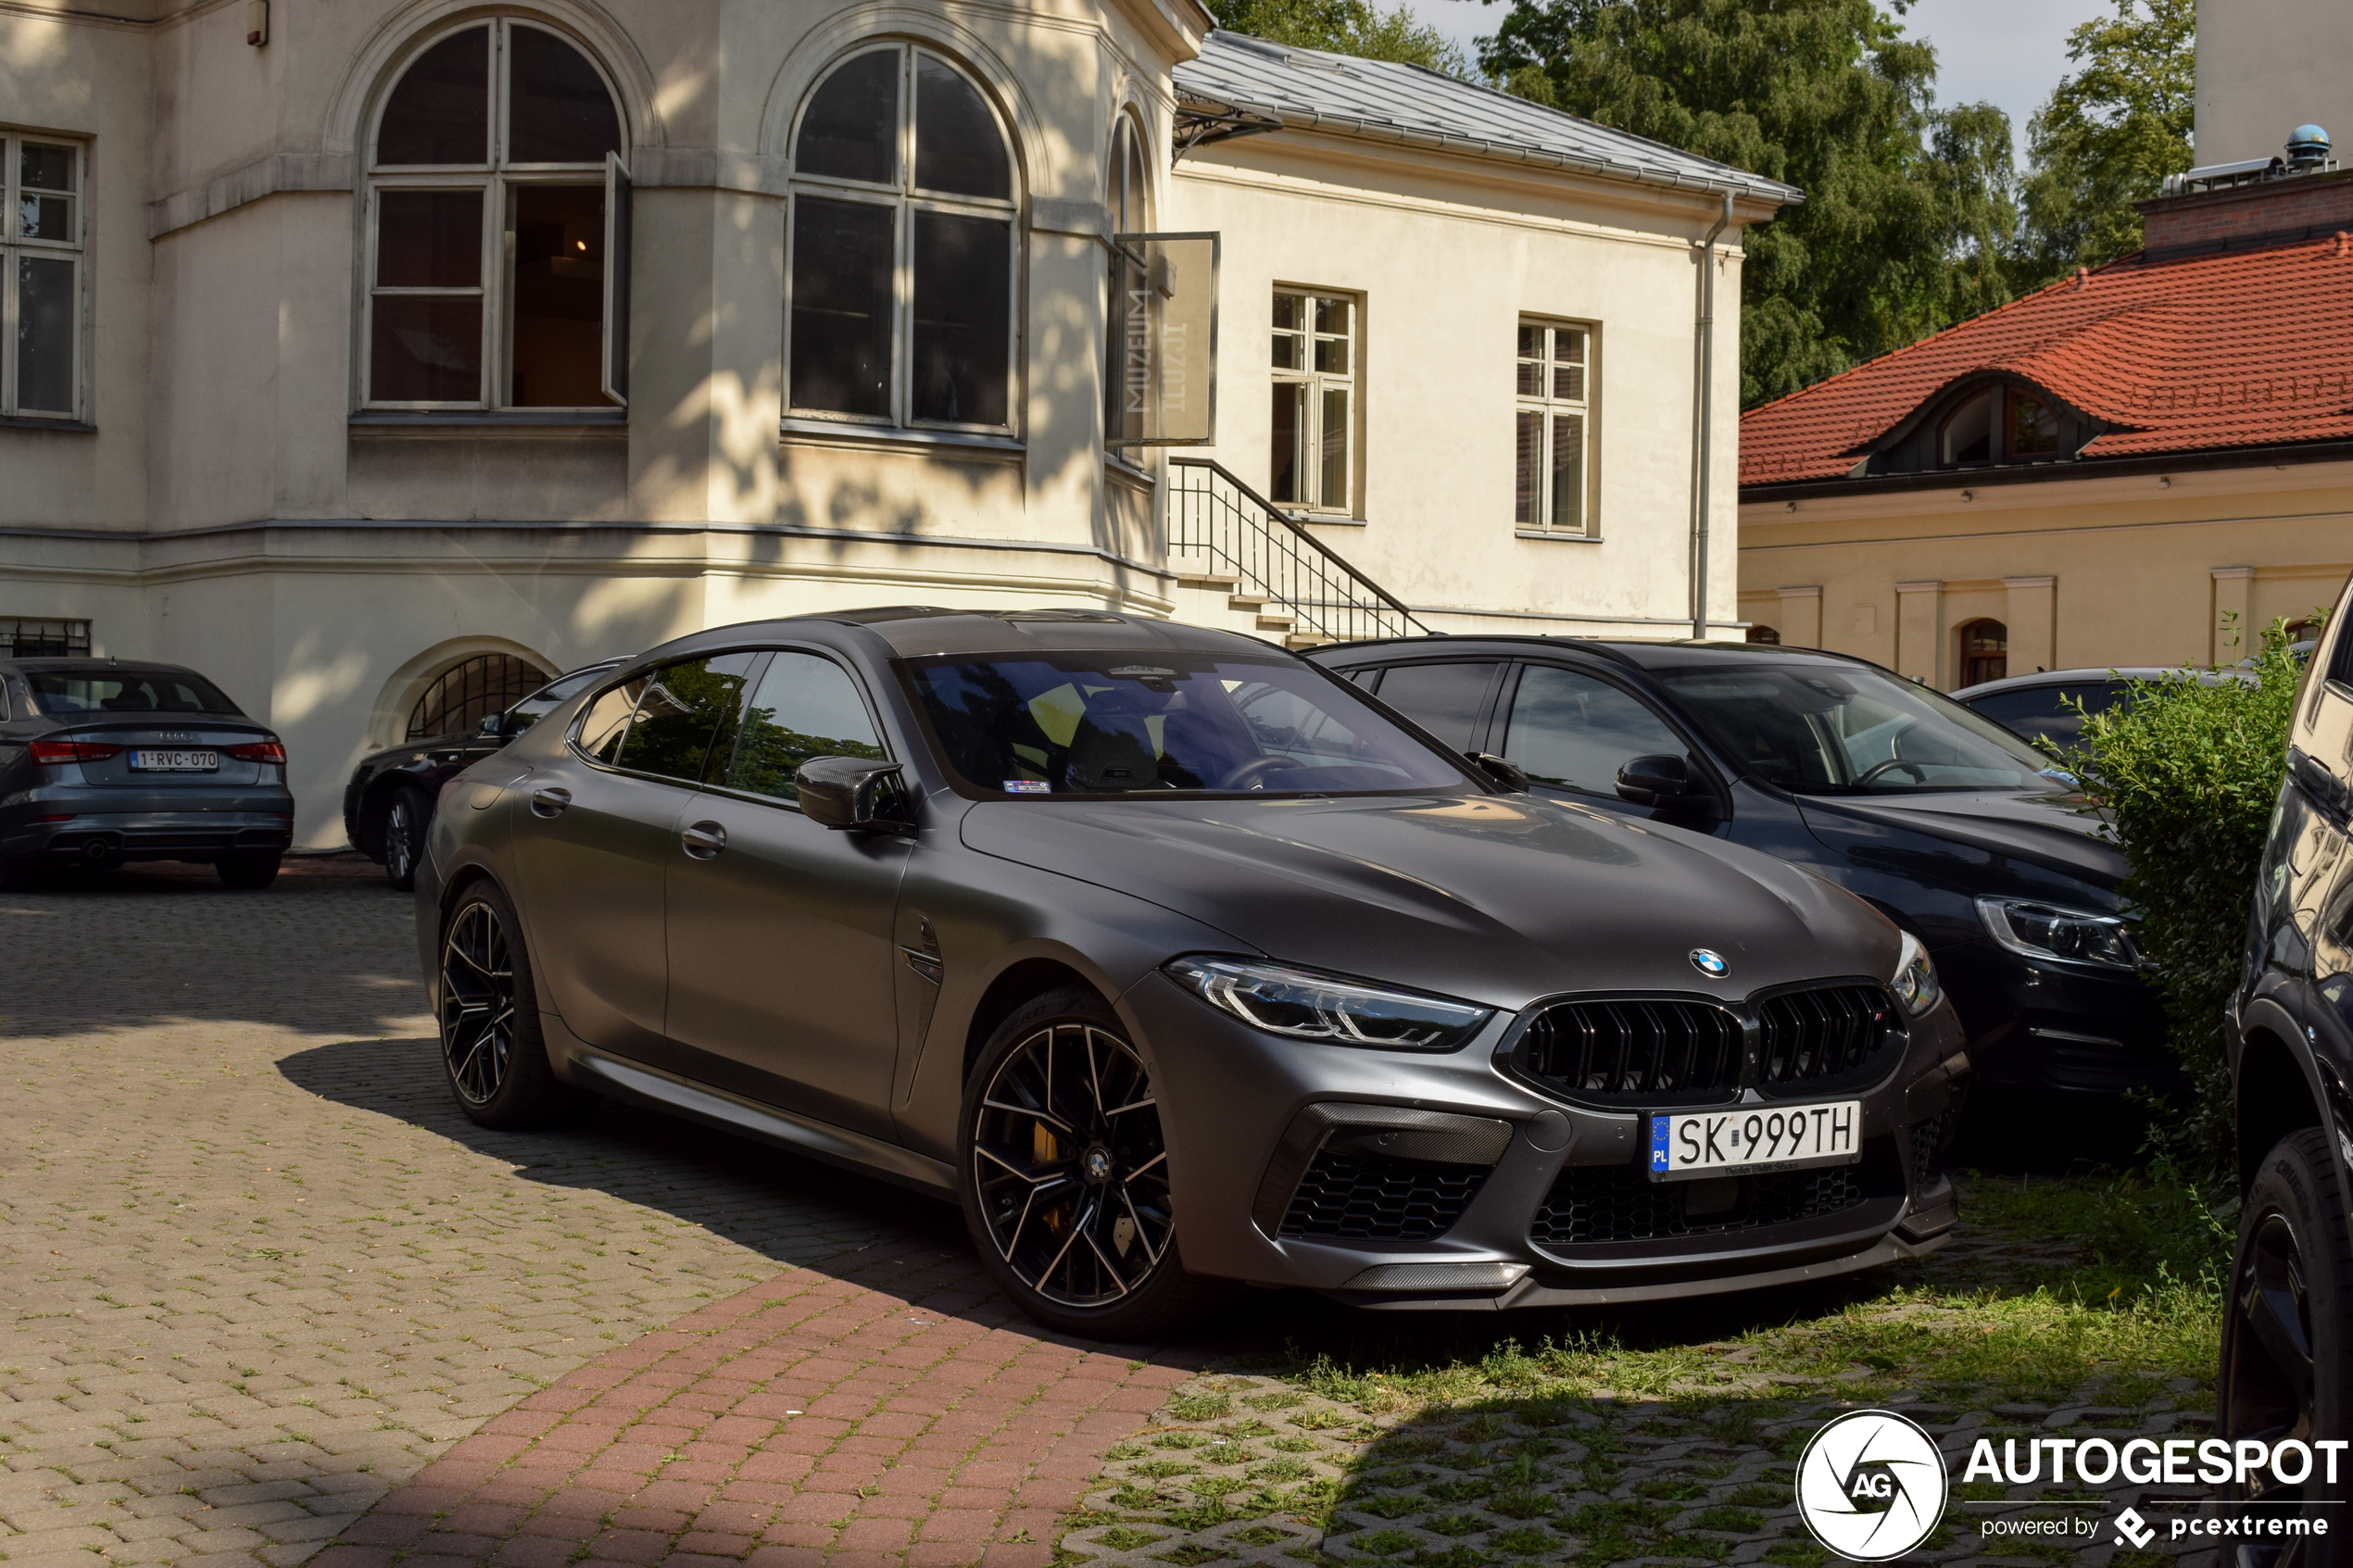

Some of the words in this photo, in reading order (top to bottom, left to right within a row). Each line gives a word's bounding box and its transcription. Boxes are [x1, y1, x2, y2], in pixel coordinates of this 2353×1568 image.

[1126, 289, 1152, 413] MUZEUM
[1162, 322, 1187, 413] ILUZJI
[1654, 1149, 1667, 1163] PL
[1679, 1116, 1728, 1164] SK
[1743, 1105, 1852, 1160] 999TH
[1752, 1163, 1773, 1173] BMW
